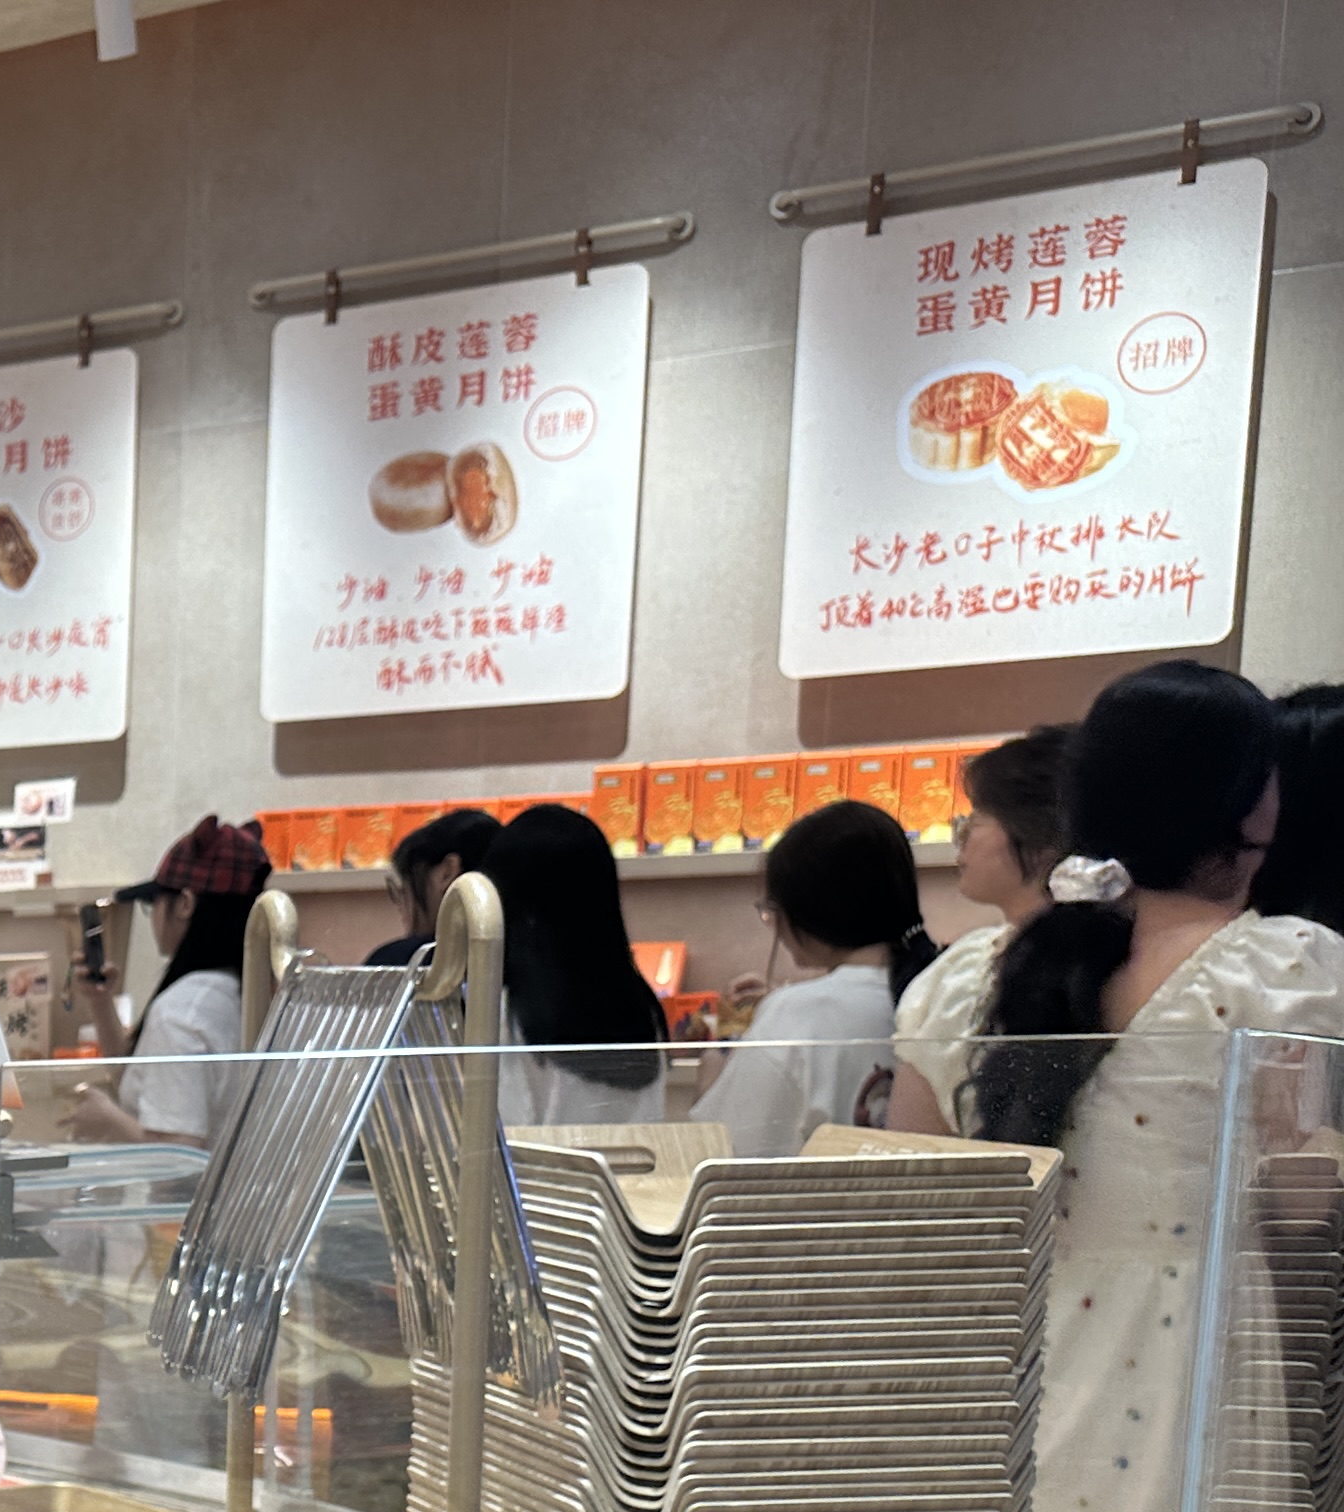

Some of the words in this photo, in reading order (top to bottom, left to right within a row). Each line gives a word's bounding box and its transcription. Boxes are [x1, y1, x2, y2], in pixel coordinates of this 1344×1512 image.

[915, 214, 1128, 284] 现烤莲蓉
[914, 268, 1125, 337] 蛋黄月饼
[367, 312, 539, 374] 酥皮莲蓉
[1127, 336, 1194, 372] 招牌
[366, 364, 537, 422] 蛋黄月饼
[533, 407, 588, 441] 招牌
